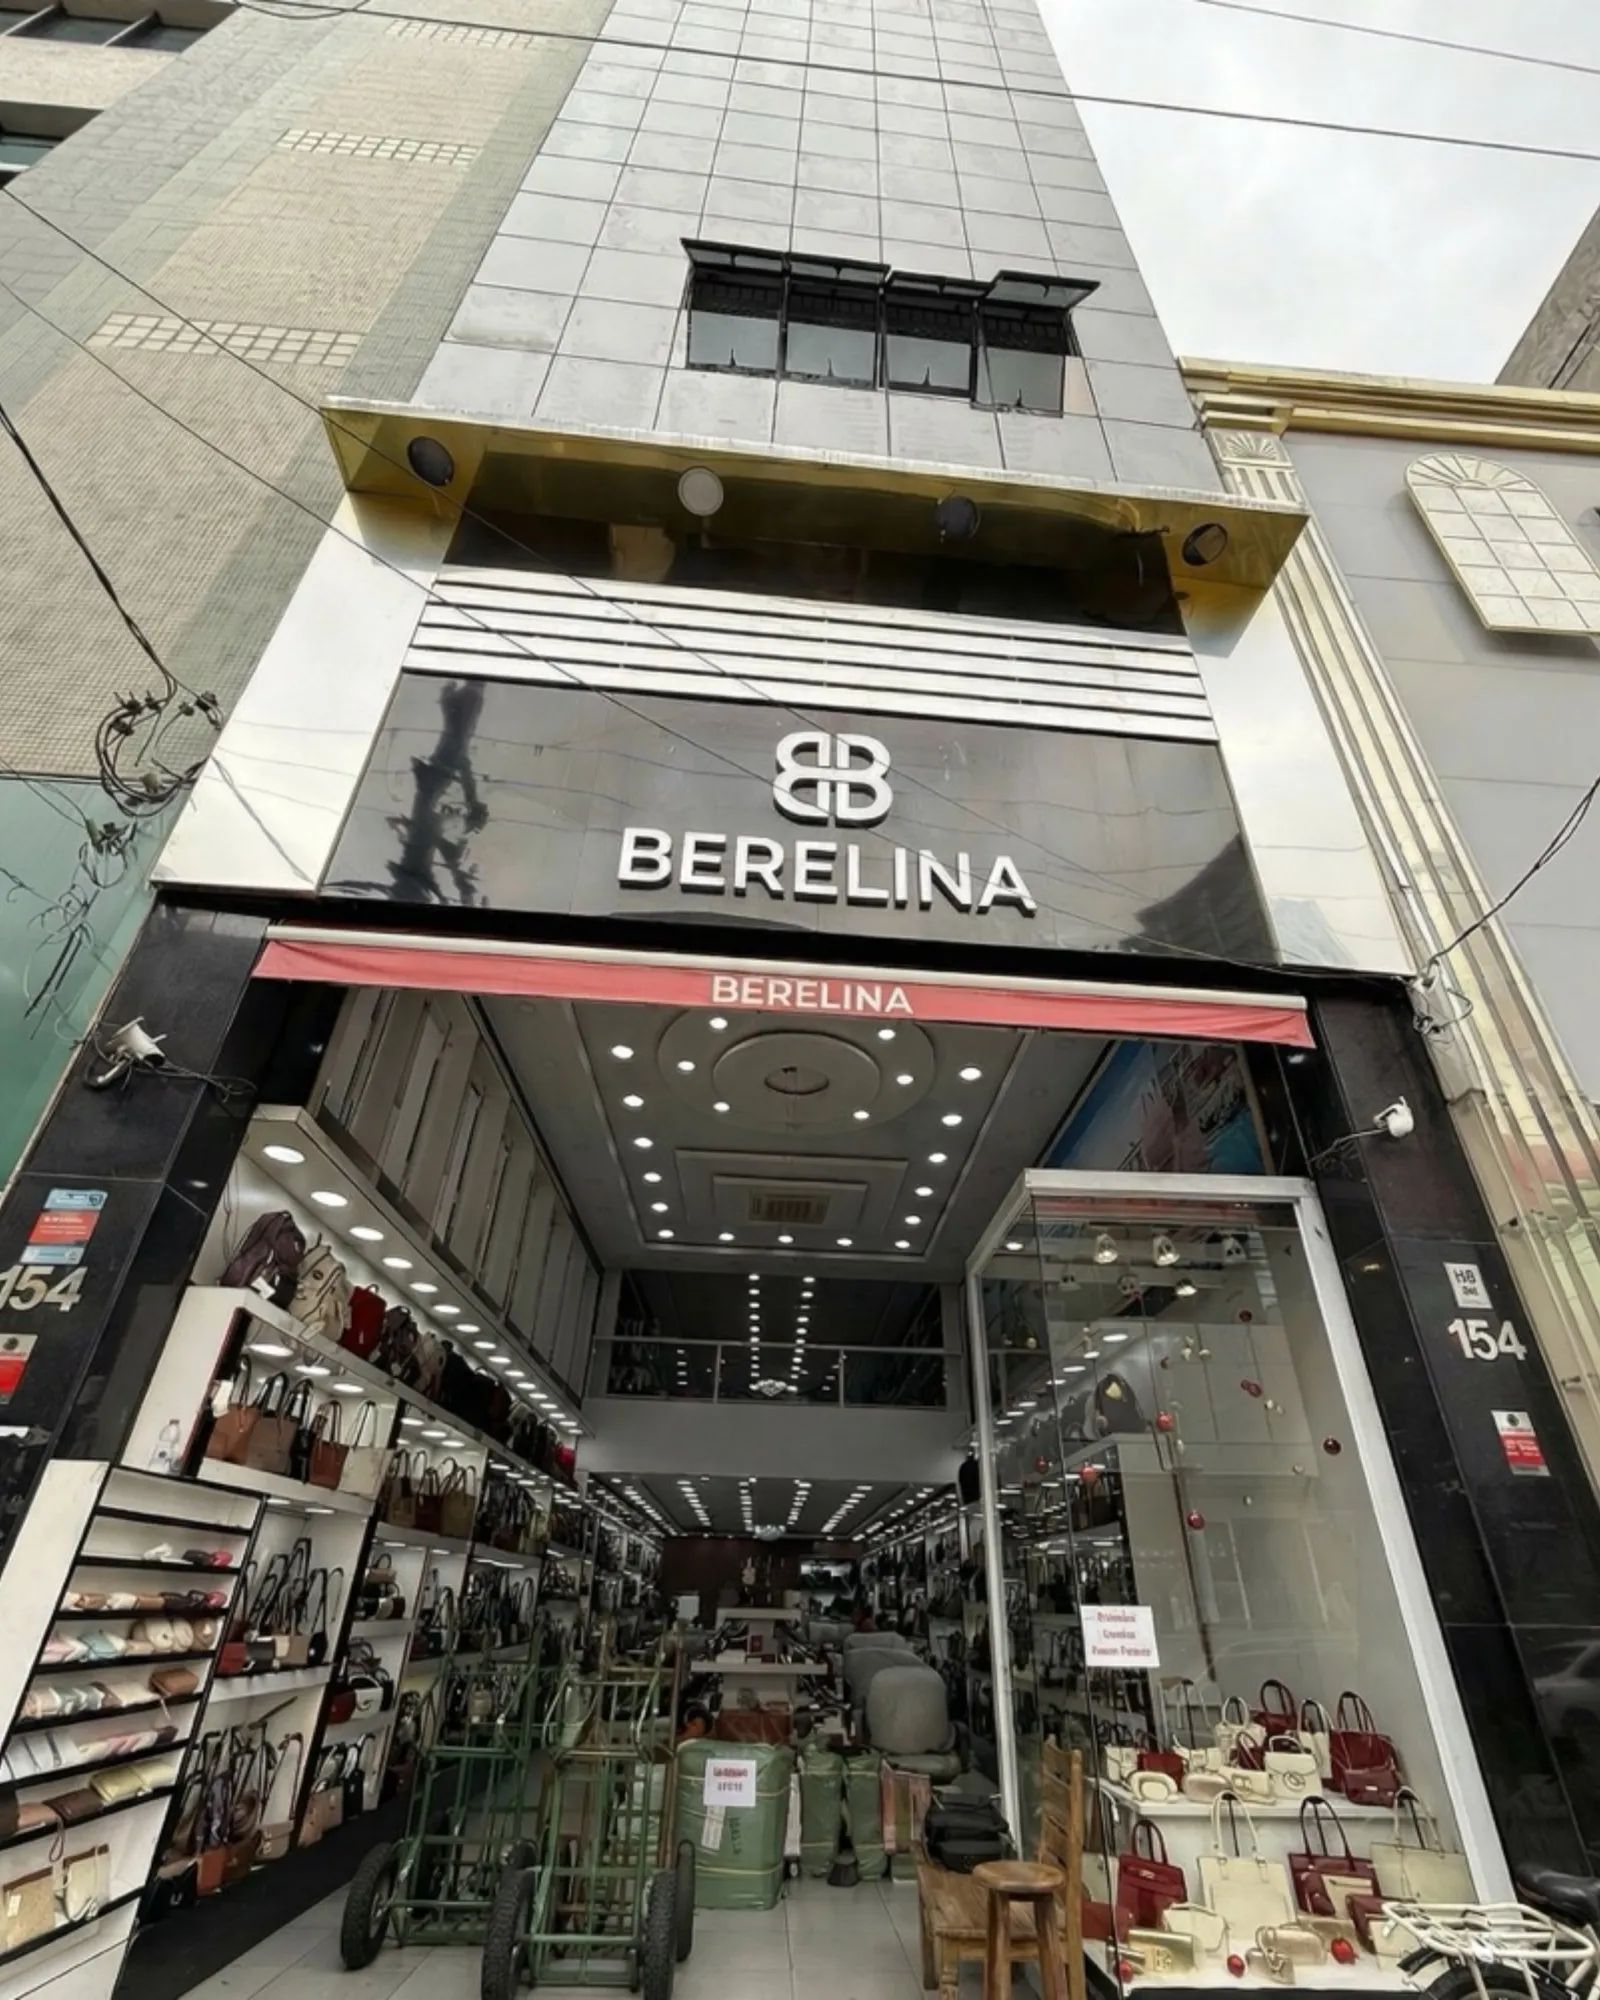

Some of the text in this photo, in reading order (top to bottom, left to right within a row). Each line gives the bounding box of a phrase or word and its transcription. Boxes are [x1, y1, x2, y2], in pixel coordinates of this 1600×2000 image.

[618, 827, 1037, 917] BERELINA
[712, 976, 913, 1014] BERELINA
[0, 1265, 88, 1312] 154
[1448, 1319, 1527, 1360] 154
